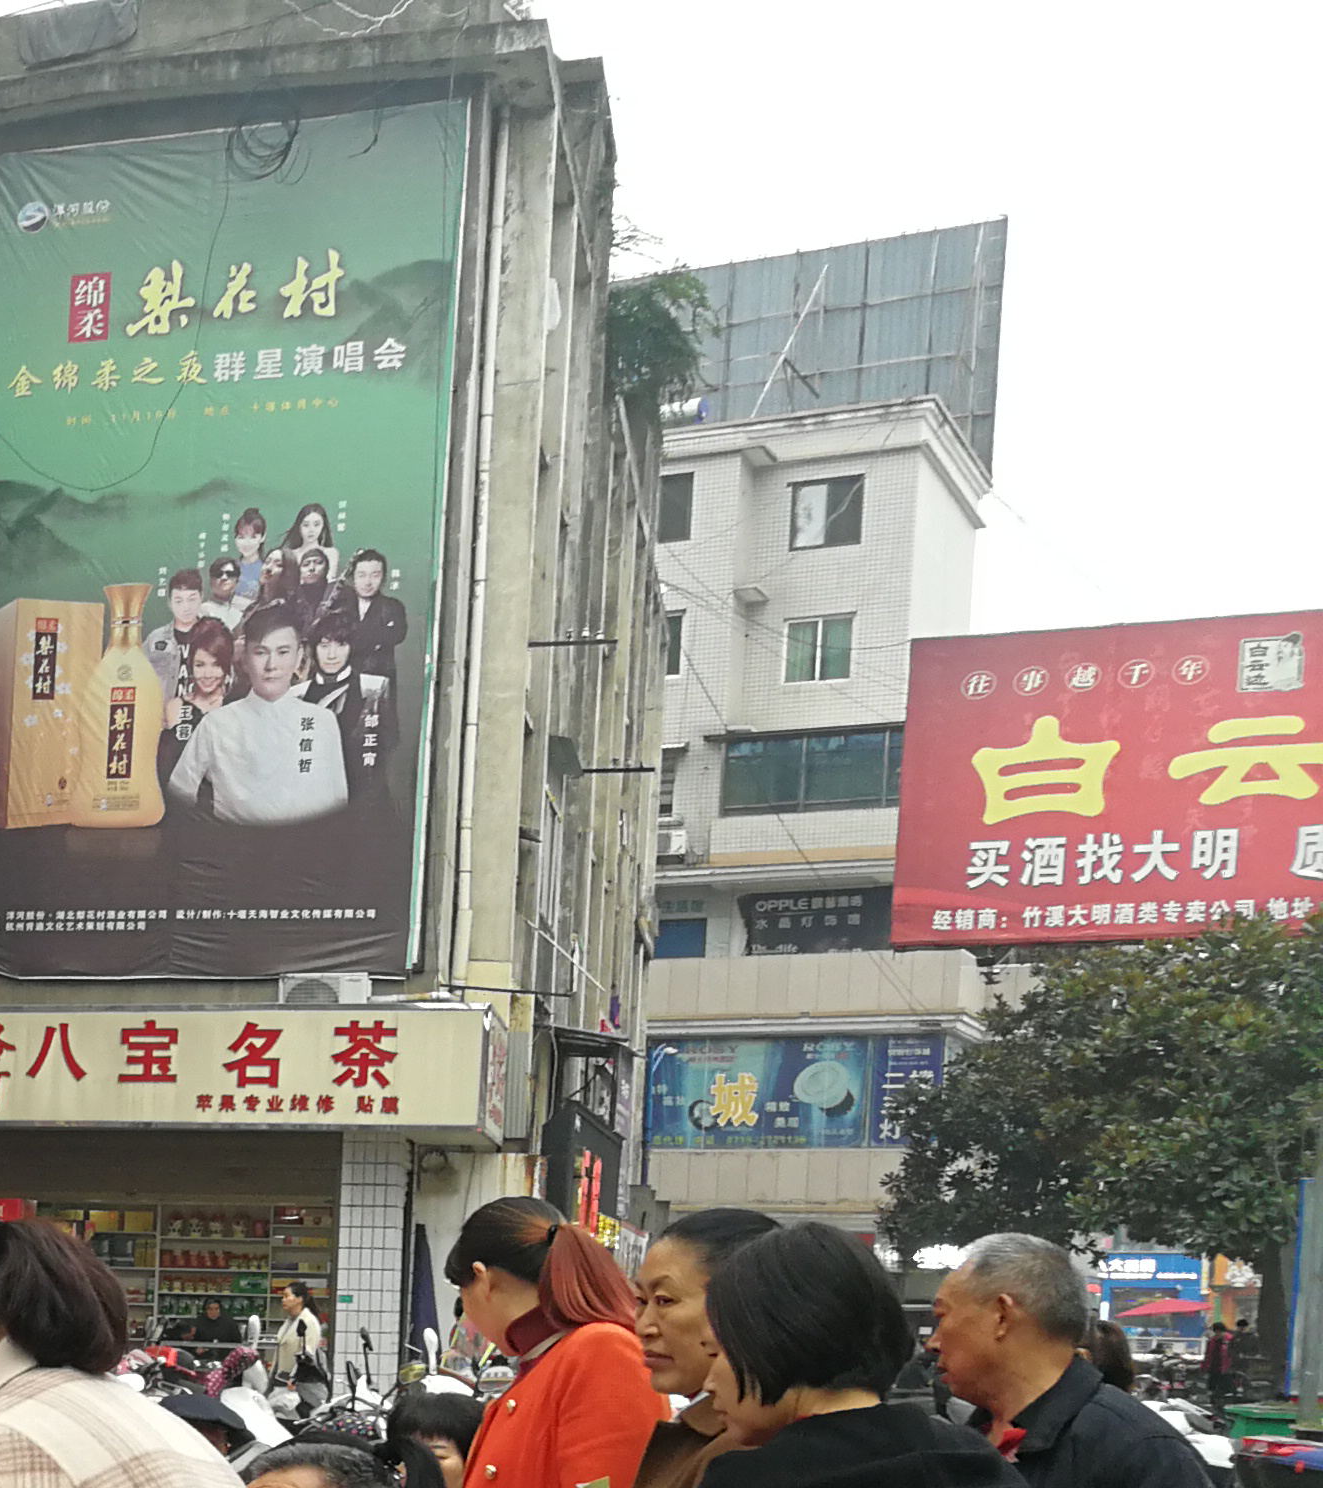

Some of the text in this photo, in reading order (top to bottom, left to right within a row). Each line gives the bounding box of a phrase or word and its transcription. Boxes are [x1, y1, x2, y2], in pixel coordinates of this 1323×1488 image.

[74, 275, 105, 339] 绵柔
[125, 249, 345, 337] 梨花村
[964, 656, 1205, 698] 往事越千年
[298, 716, 315, 774] 张信哲
[971, 714, 1323, 826] 白云
[965, 828, 1241, 889] 买酒找大明
[755, 898, 809, 912] OPPLE
[25, 1019, 399, 1089] 八宝名茶
[194, 1093, 400, 1115] 苹果专业维修 贴膜
[710, 1072, 759, 1127] 城
